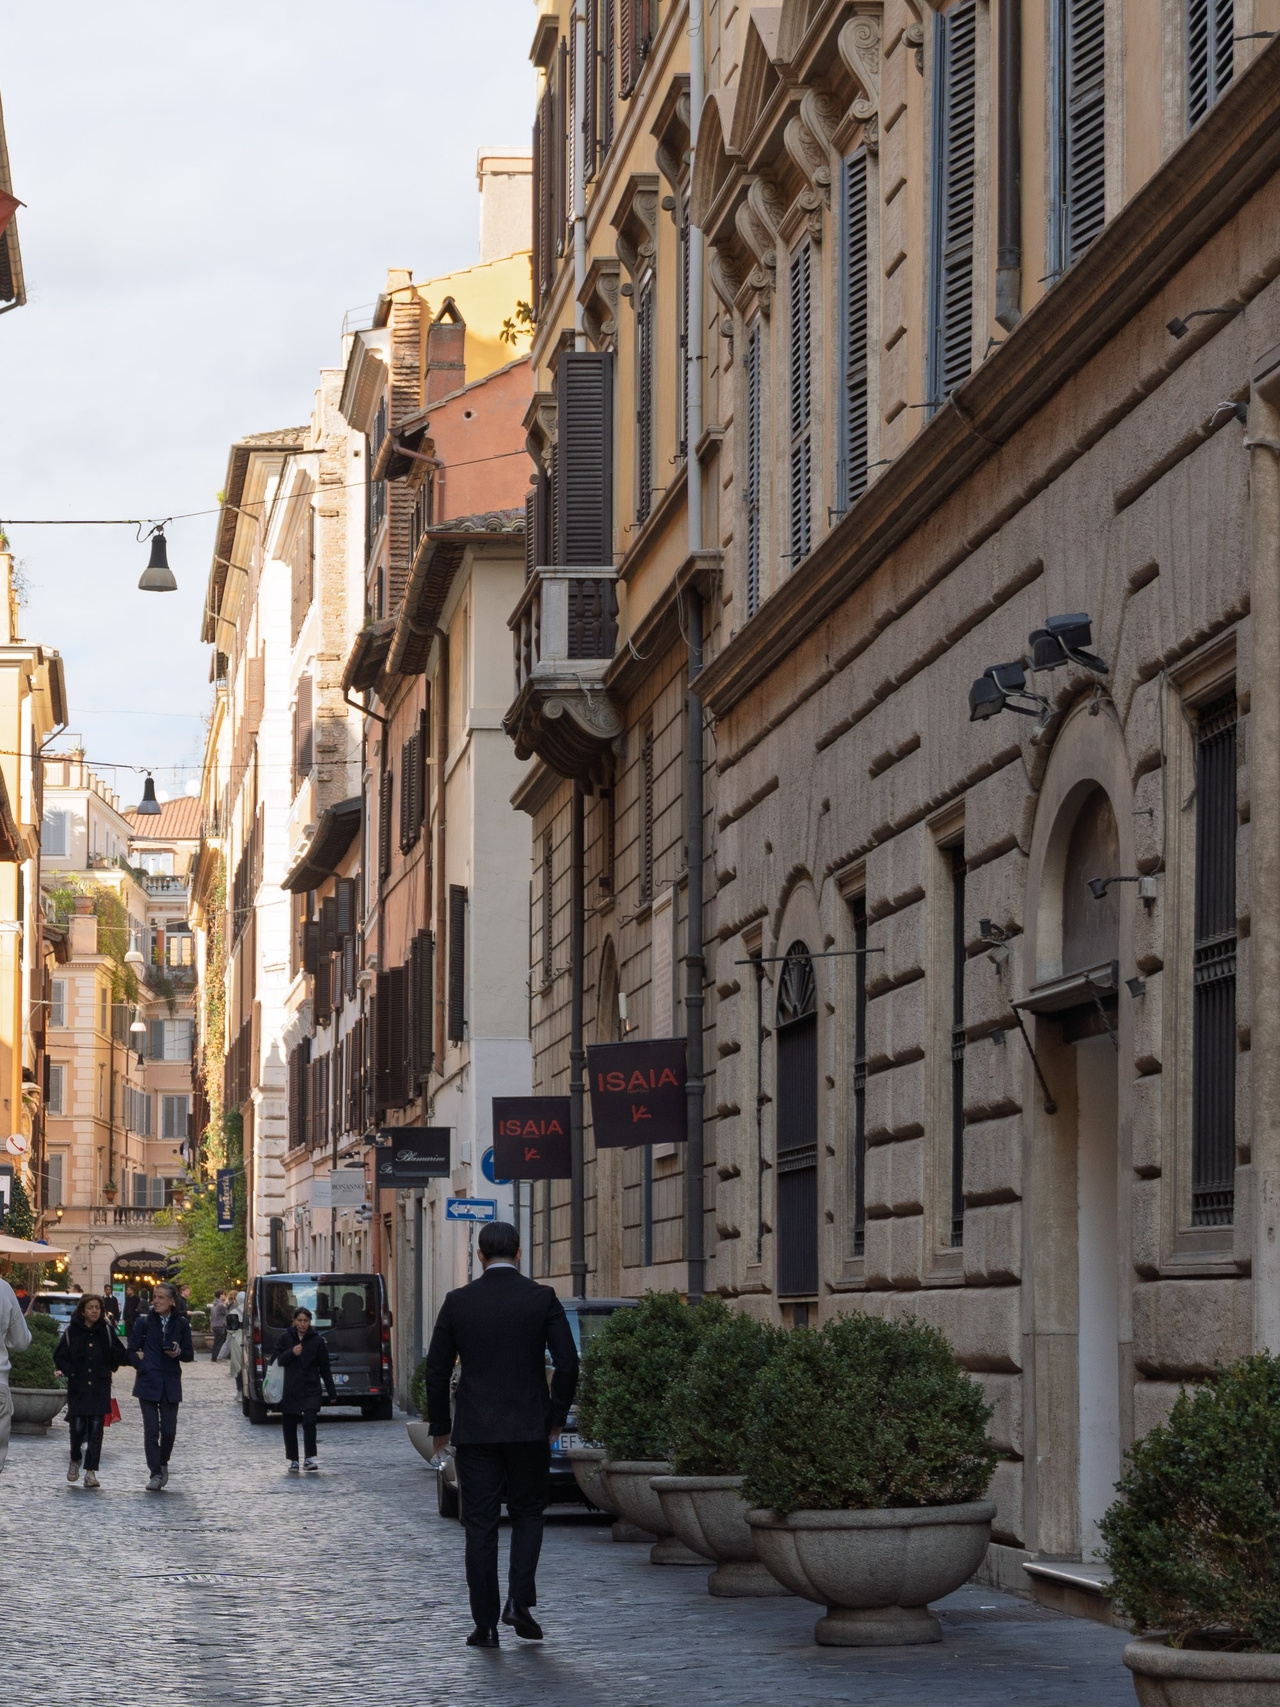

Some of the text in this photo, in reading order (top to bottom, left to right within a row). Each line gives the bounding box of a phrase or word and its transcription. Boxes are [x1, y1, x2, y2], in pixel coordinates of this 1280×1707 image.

[597, 1067, 679, 1092] ISAIA
[499, 1119, 564, 1136] ISAIA
[395, 1149, 446, 1162] Blumarine
